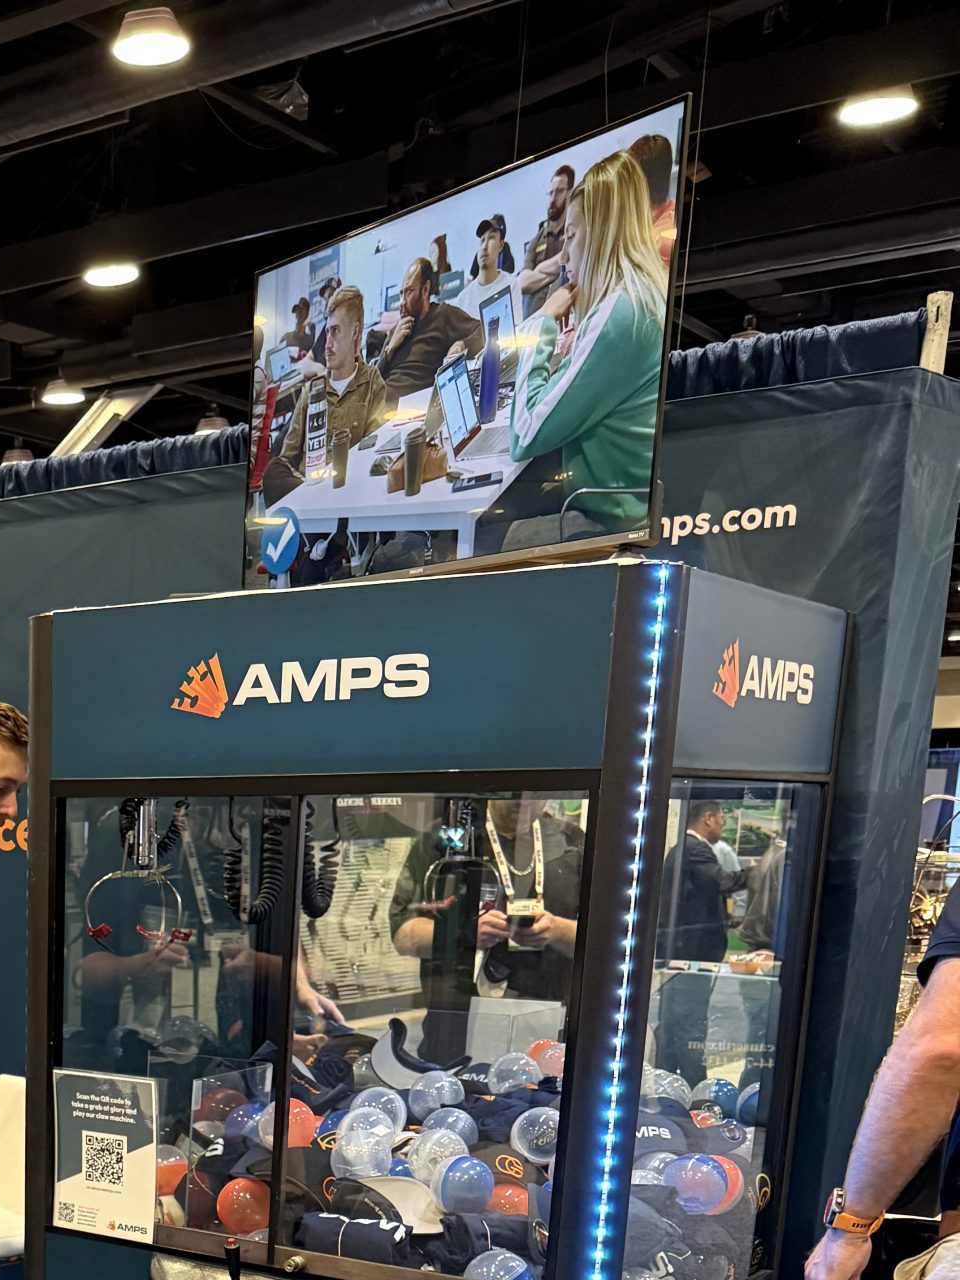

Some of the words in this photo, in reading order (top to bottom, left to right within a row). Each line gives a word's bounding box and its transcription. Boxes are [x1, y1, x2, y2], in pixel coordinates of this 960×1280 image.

[232, 653, 430, 706] AMPS
[740, 654, 815, 705] AMPS
[76, 1092, 89, 1100] Scan
[90, 1094, 100, 1102] the
[100, 1095, 110, 1103] QR
[110, 1097, 124, 1105] code
[125, 1098, 131, 1106] to
[71, 1100, 84, 1108] take
[110, 1106, 124, 1114] glory
[125, 1107, 137, 1115] and
[72, 1109, 85, 1118] play
[96, 1112, 109, 1120] claw
[635, 1125, 672, 1138] MPS
[117, 1222, 148, 1235] AMPS
